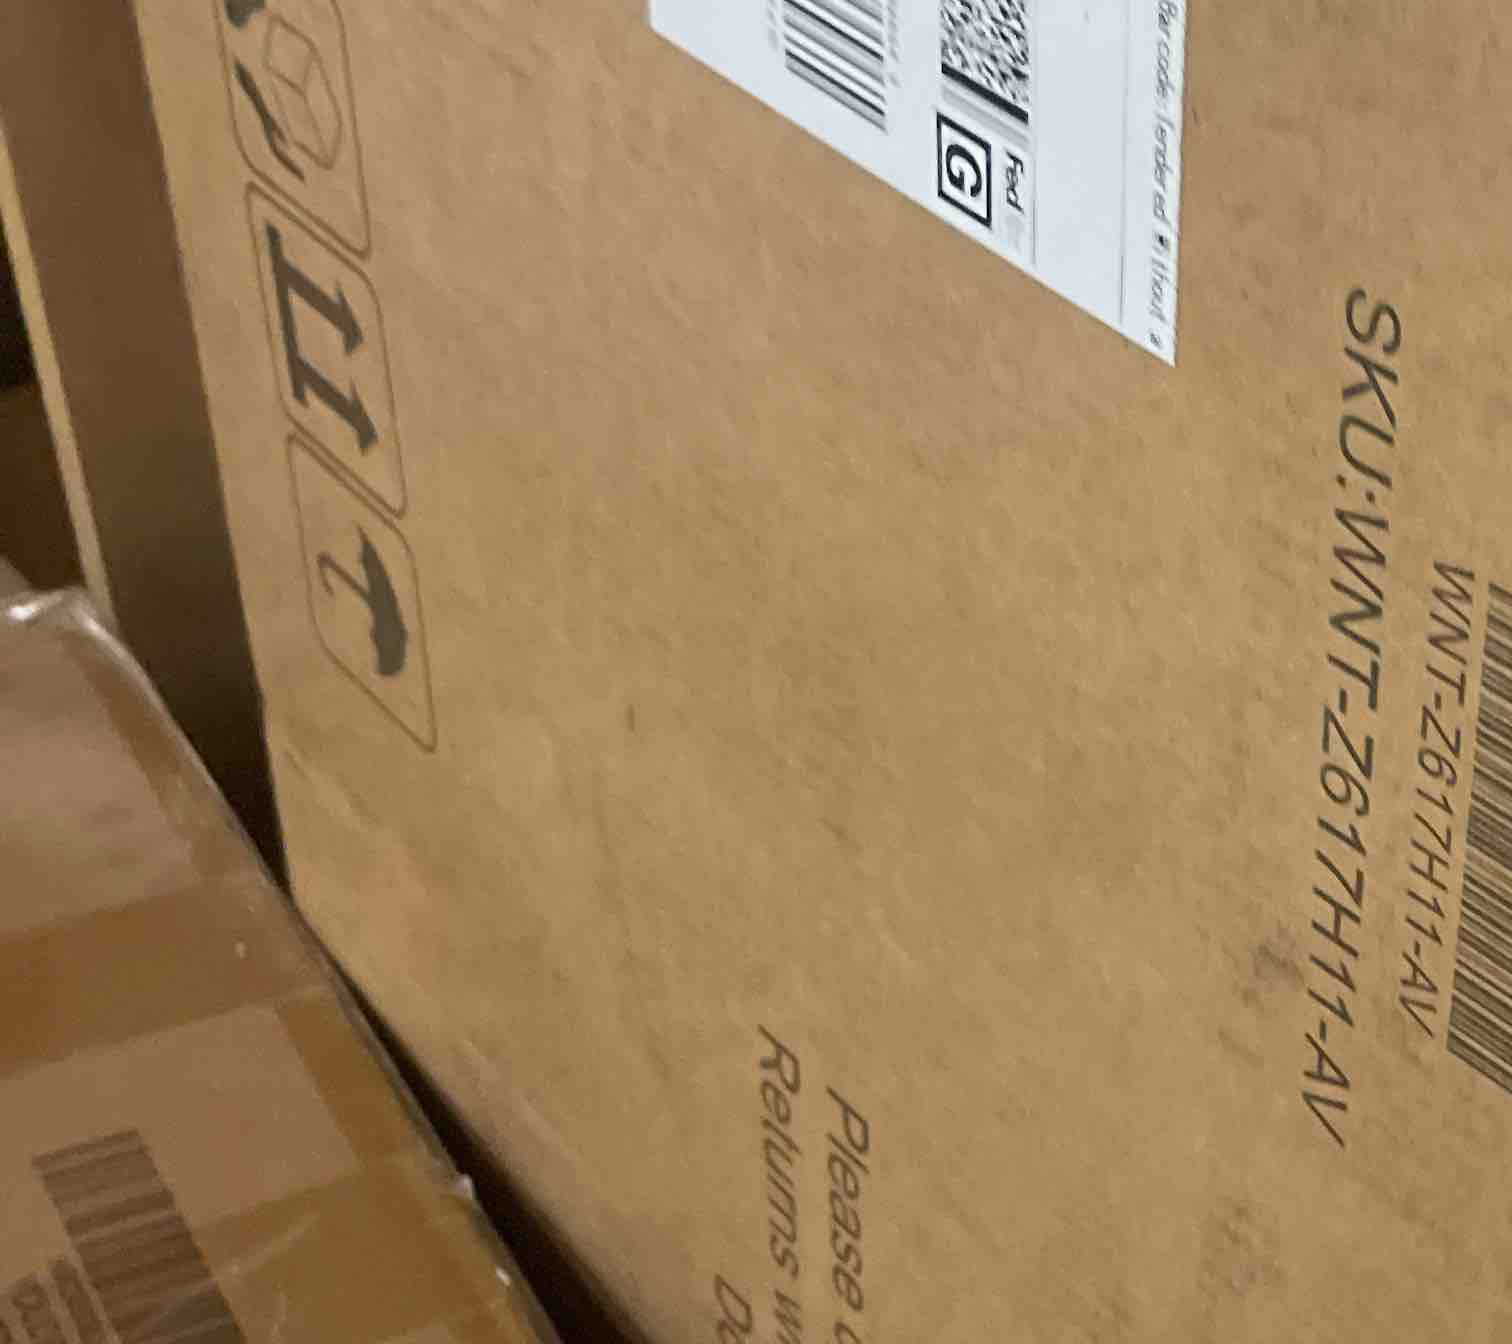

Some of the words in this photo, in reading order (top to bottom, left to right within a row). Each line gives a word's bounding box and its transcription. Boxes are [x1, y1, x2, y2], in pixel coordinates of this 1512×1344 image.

[945, 143, 982, 198] G
[1301, 288, 1401, 1148] SKU:WNT-Z617H11-AV
[1399, 560, 1475, 1038] WNT-Z617H11-AV
[757, 1024, 801, 1280] Returns
[826, 1086, 870, 1312] Please
